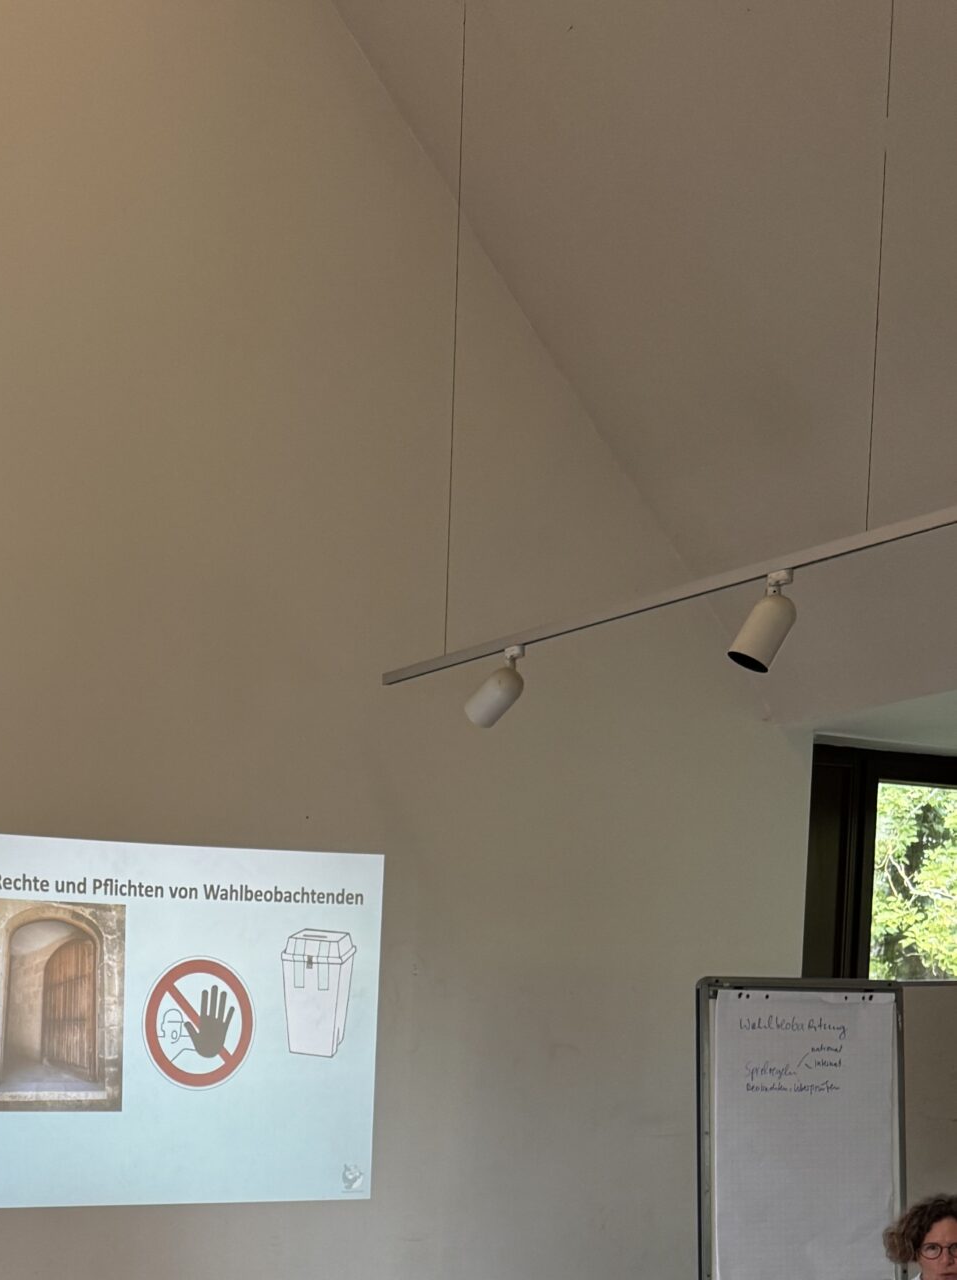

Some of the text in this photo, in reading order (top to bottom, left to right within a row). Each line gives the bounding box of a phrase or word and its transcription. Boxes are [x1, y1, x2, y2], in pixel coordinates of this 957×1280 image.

[55, 878, 87, 895] und
[92, 878, 165, 900] Pflichten
[169, 886, 199, 901] von
[204, 884, 365, 906] Wahlbeobachtenden
